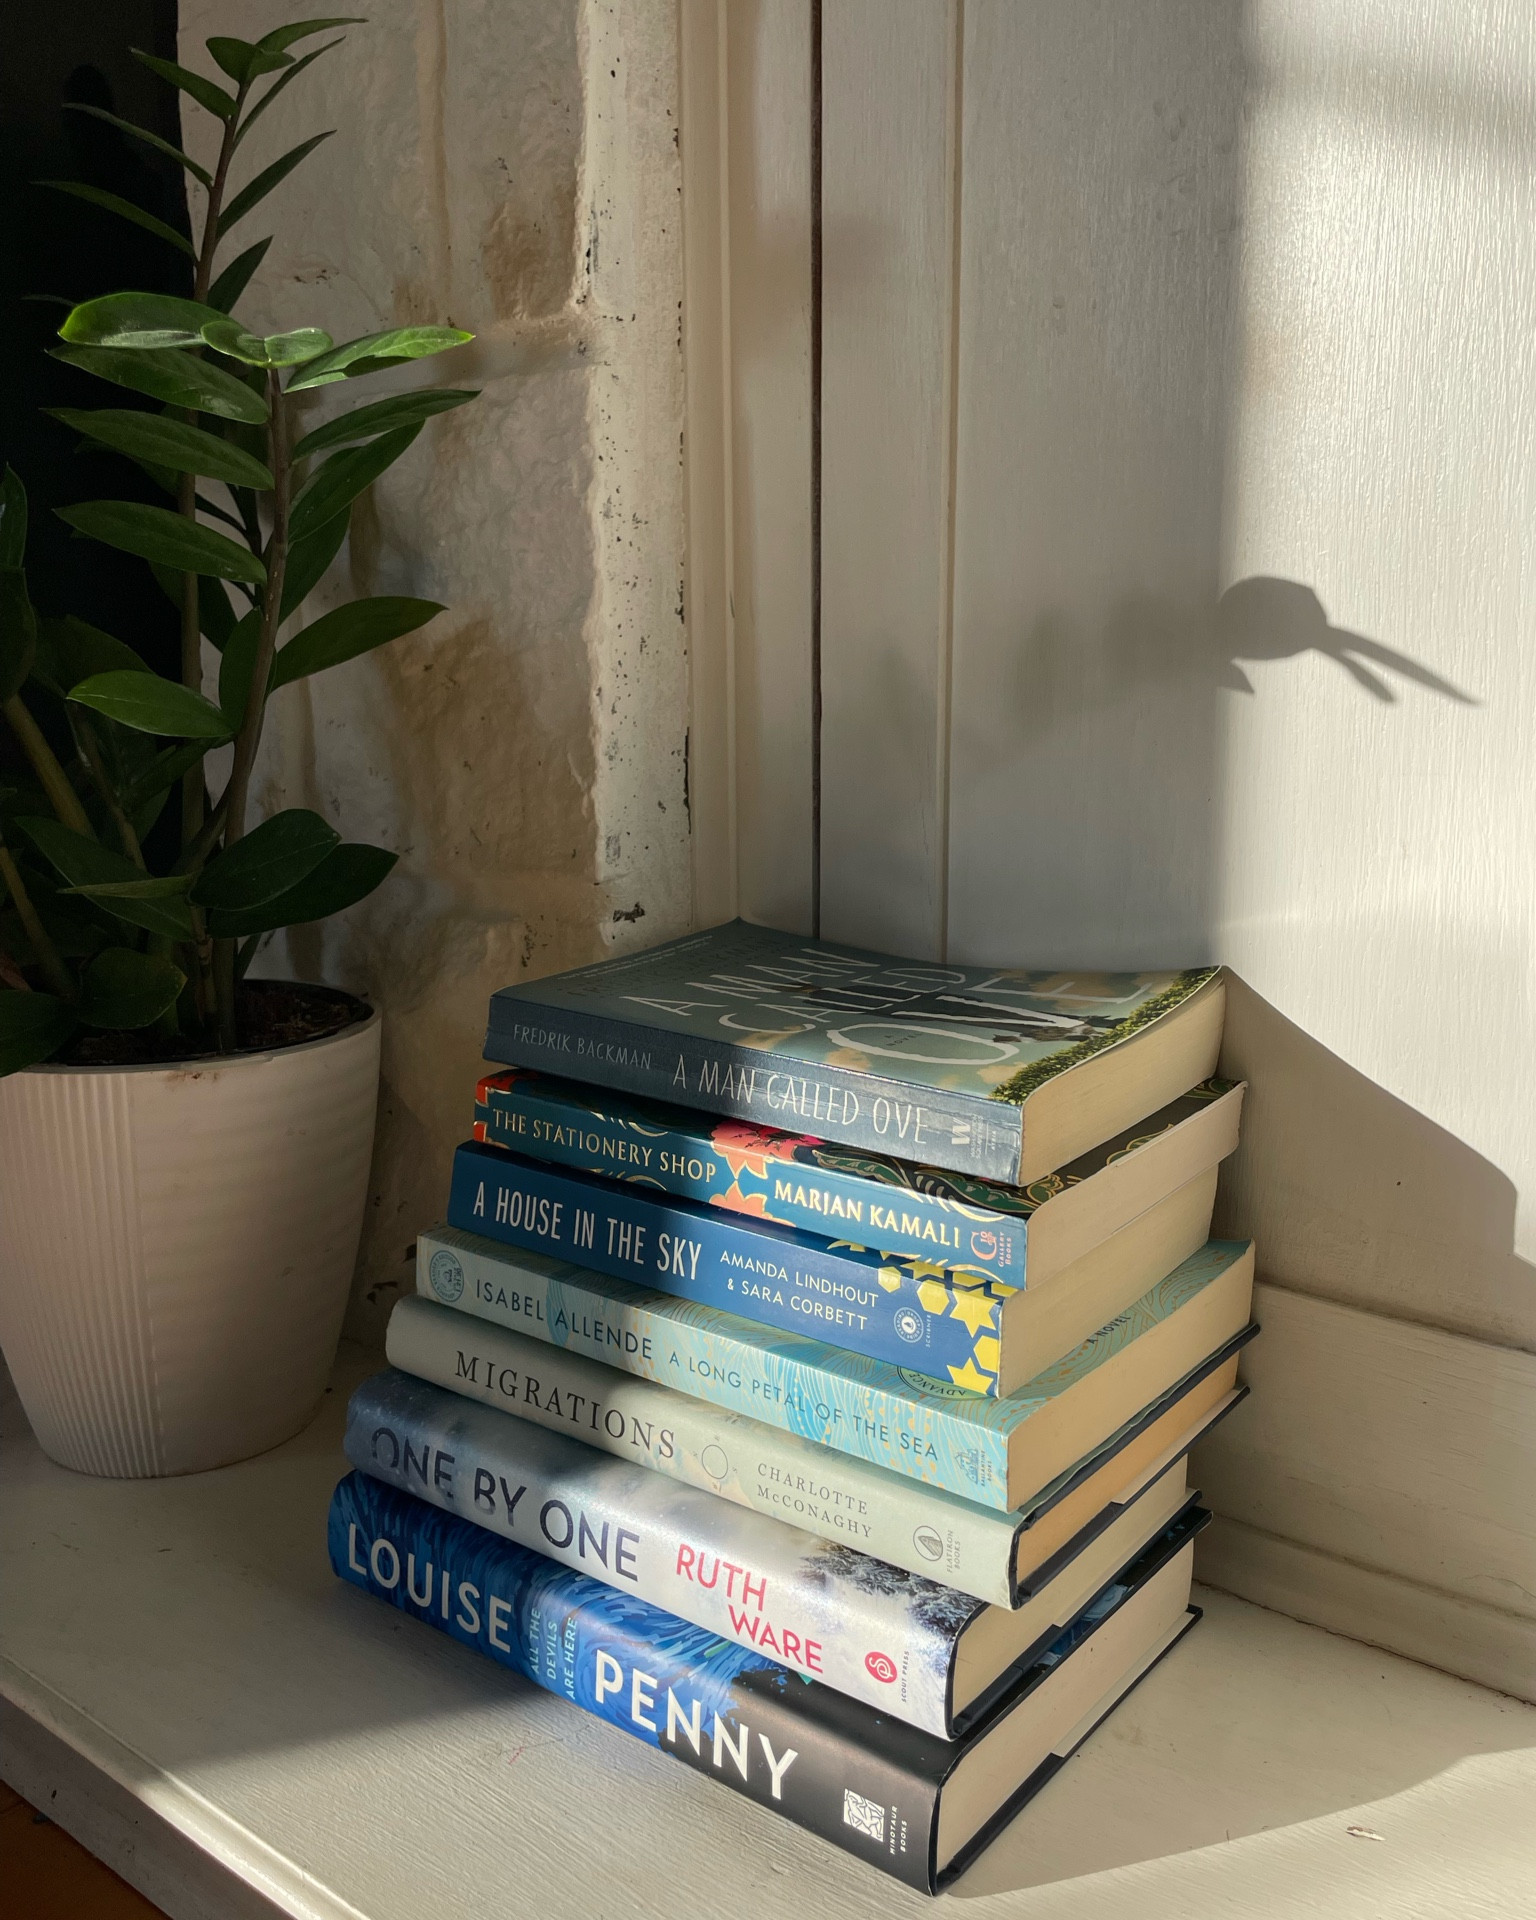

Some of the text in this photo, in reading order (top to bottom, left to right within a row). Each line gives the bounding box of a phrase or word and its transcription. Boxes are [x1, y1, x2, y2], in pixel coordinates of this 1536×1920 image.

[619, 996, 729, 1017] A
[685, 948, 880, 1000] MAN
[718, 957, 966, 1034] CALLED
[826, 976, 1152, 1065] OVE
[513, 1024, 929, 1144] FREDRIK BACKMAN A MAN CALLED OVE
[493, 1108, 961, 1248] THE STATIONERY SHOP MARJAN KAMALI
[473, 1181, 702, 1280] A HOUSE IN THE SKY
[720, 1250, 879, 1308] AMANDA LINDHOUT
[727, 1278, 868, 1331] & SARA CORBETT
[1094, 1315, 1131, 1337] NOVEL
[476, 1279, 938, 1461] ISABEL ALLENDE A LONG PETAL OF THE SEA
[455, 1351, 675, 1459] MIGRATIONS
[371, 1427, 640, 1582] ONE BY ONE
[757, 1463, 868, 1515] CHARLOTTE
[757, 1484, 873, 1538] McCONAGHY
[348, 1522, 512, 1653] LOUISE
[676, 1543, 767, 1612] RUTH
[529, 1607, 541, 1675] ALL THE
[546, 1621, 558, 1680] DEVILS
[564, 1616, 578, 1700] ARE HERE
[728, 1604, 824, 1674] WARE
[902, 1650, 910, 1675] PRESS
[595, 1648, 798, 1800] PENNY
[889, 1805, 898, 1854] MINOTAUR
[899, 1819, 908, 1853] BOOKS
